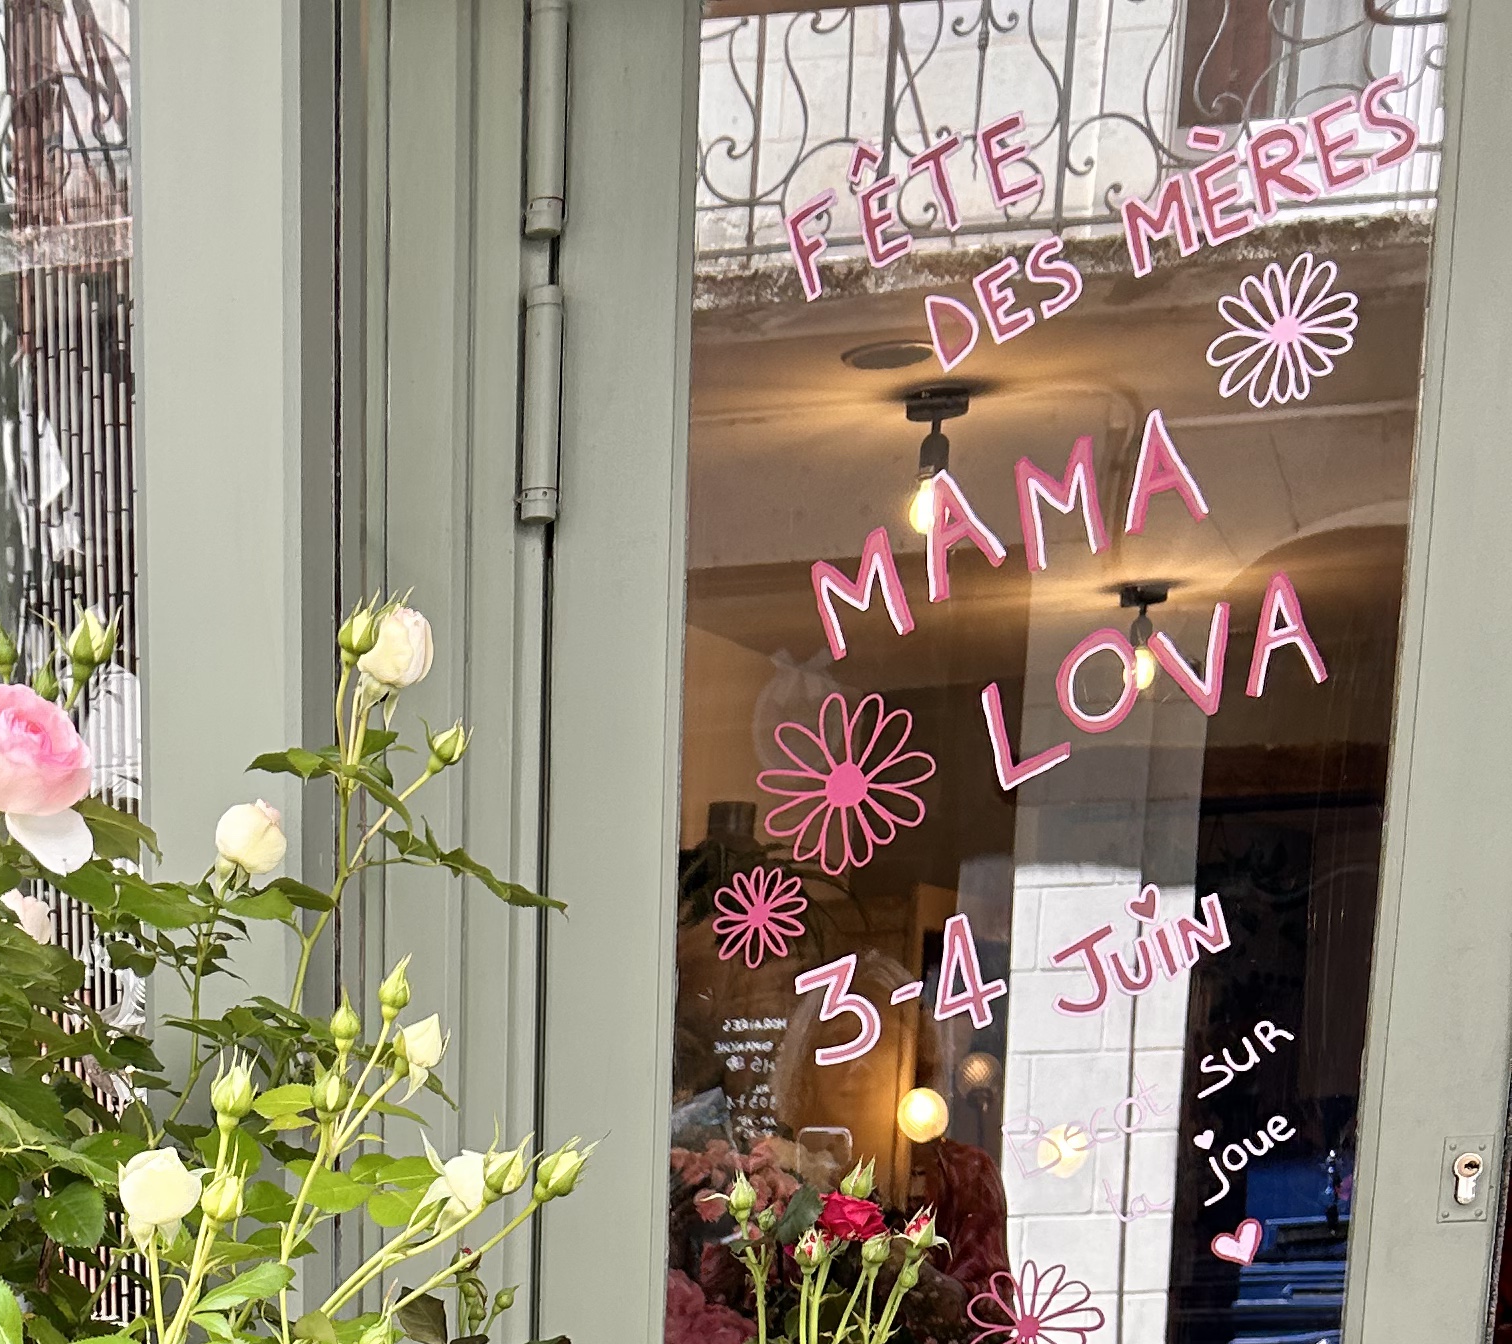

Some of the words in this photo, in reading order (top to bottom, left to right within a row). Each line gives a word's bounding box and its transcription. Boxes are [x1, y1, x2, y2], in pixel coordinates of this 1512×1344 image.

[783, 110, 1044, 302] FÊTE
[923, 235, 1084, 372] DES
[1121, 71, 1419, 278] MÈRES
[810, 409, 1209, 660] MAMA
[980, 572, 1328, 791] LOVA
[795, 912, 1007, 1066] 3-4
